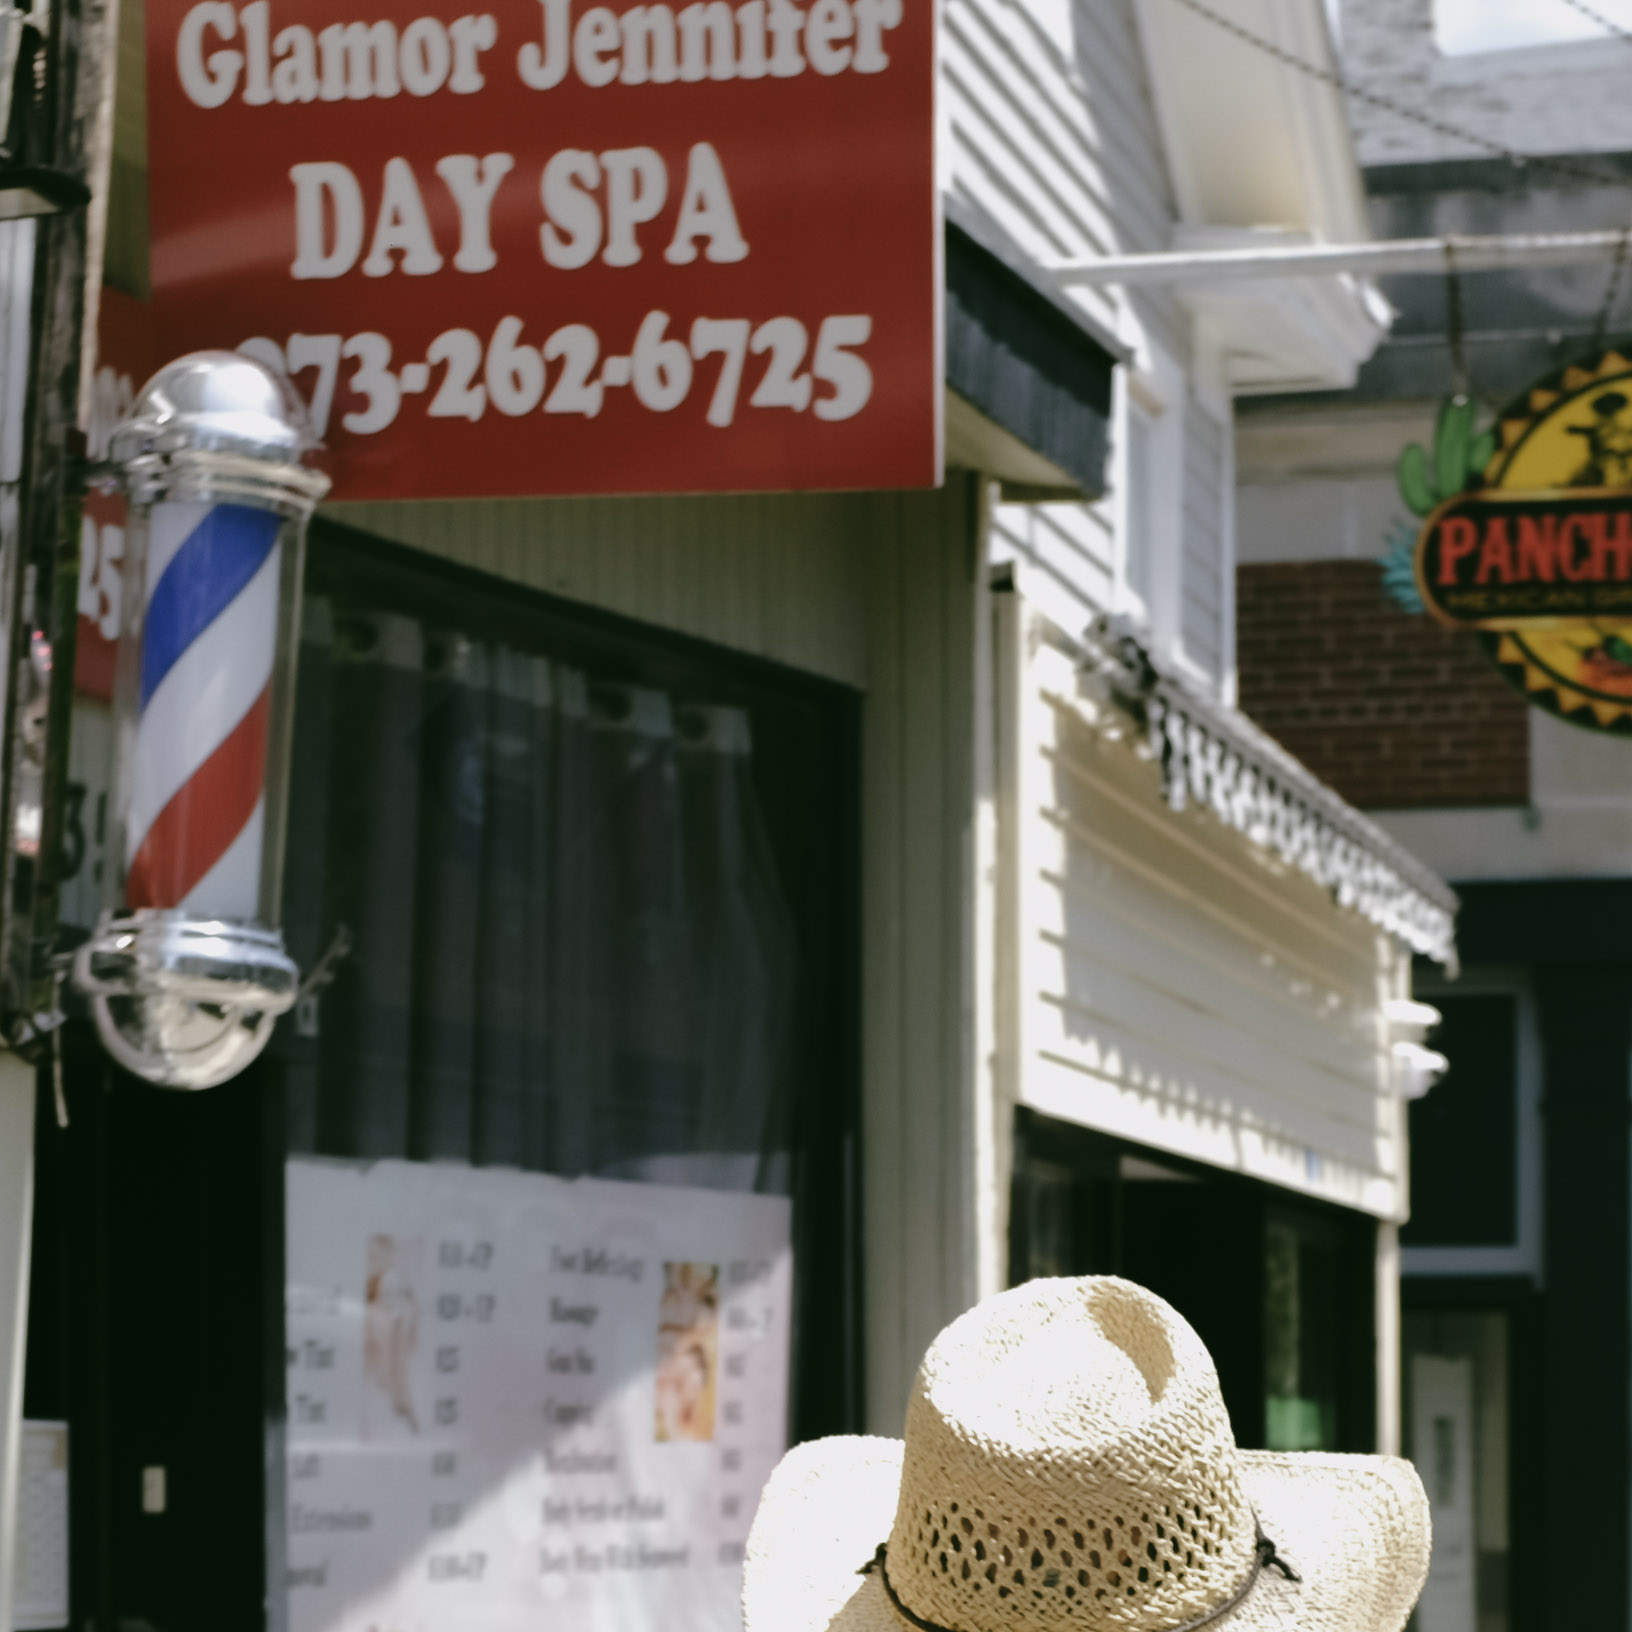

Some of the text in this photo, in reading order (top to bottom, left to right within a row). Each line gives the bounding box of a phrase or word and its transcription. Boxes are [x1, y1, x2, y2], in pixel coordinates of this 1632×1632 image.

[176, 0, 904, 109] Glamor Jennifer
[289, 140, 750, 280] DAY SPA
